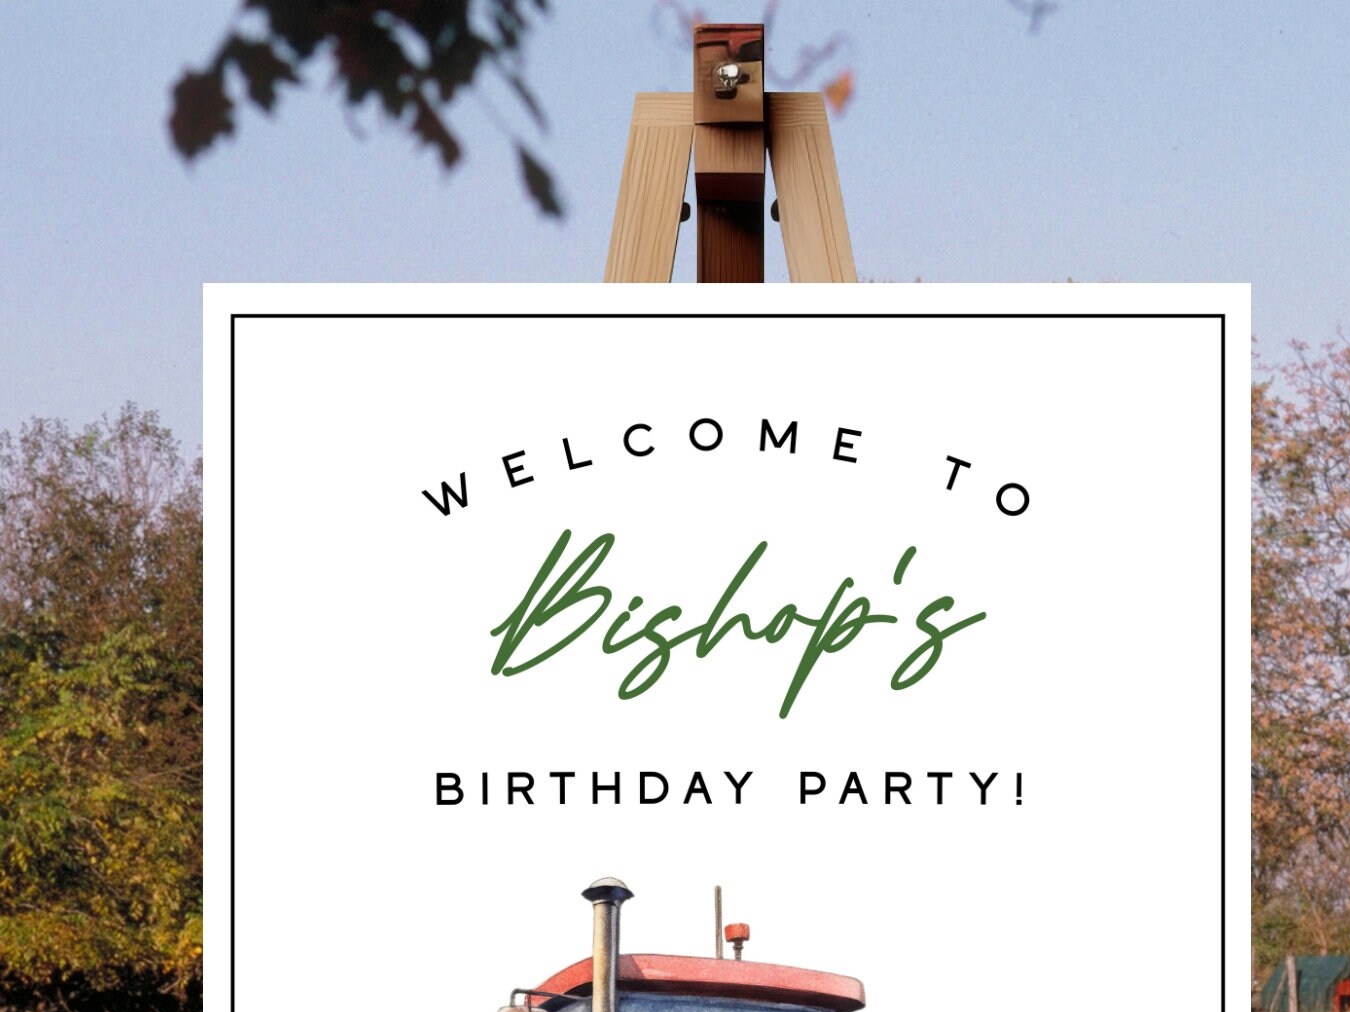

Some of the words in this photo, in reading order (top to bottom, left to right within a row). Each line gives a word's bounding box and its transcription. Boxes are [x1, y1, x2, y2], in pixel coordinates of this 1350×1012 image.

[421, 418, 863, 517] WELCOME
[945, 454, 1030, 517] TO
[489, 528, 988, 721] Bishop's
[436, 771, 754, 806] BIRTHDAY
[799, 771, 1024, 806] PARTY!
